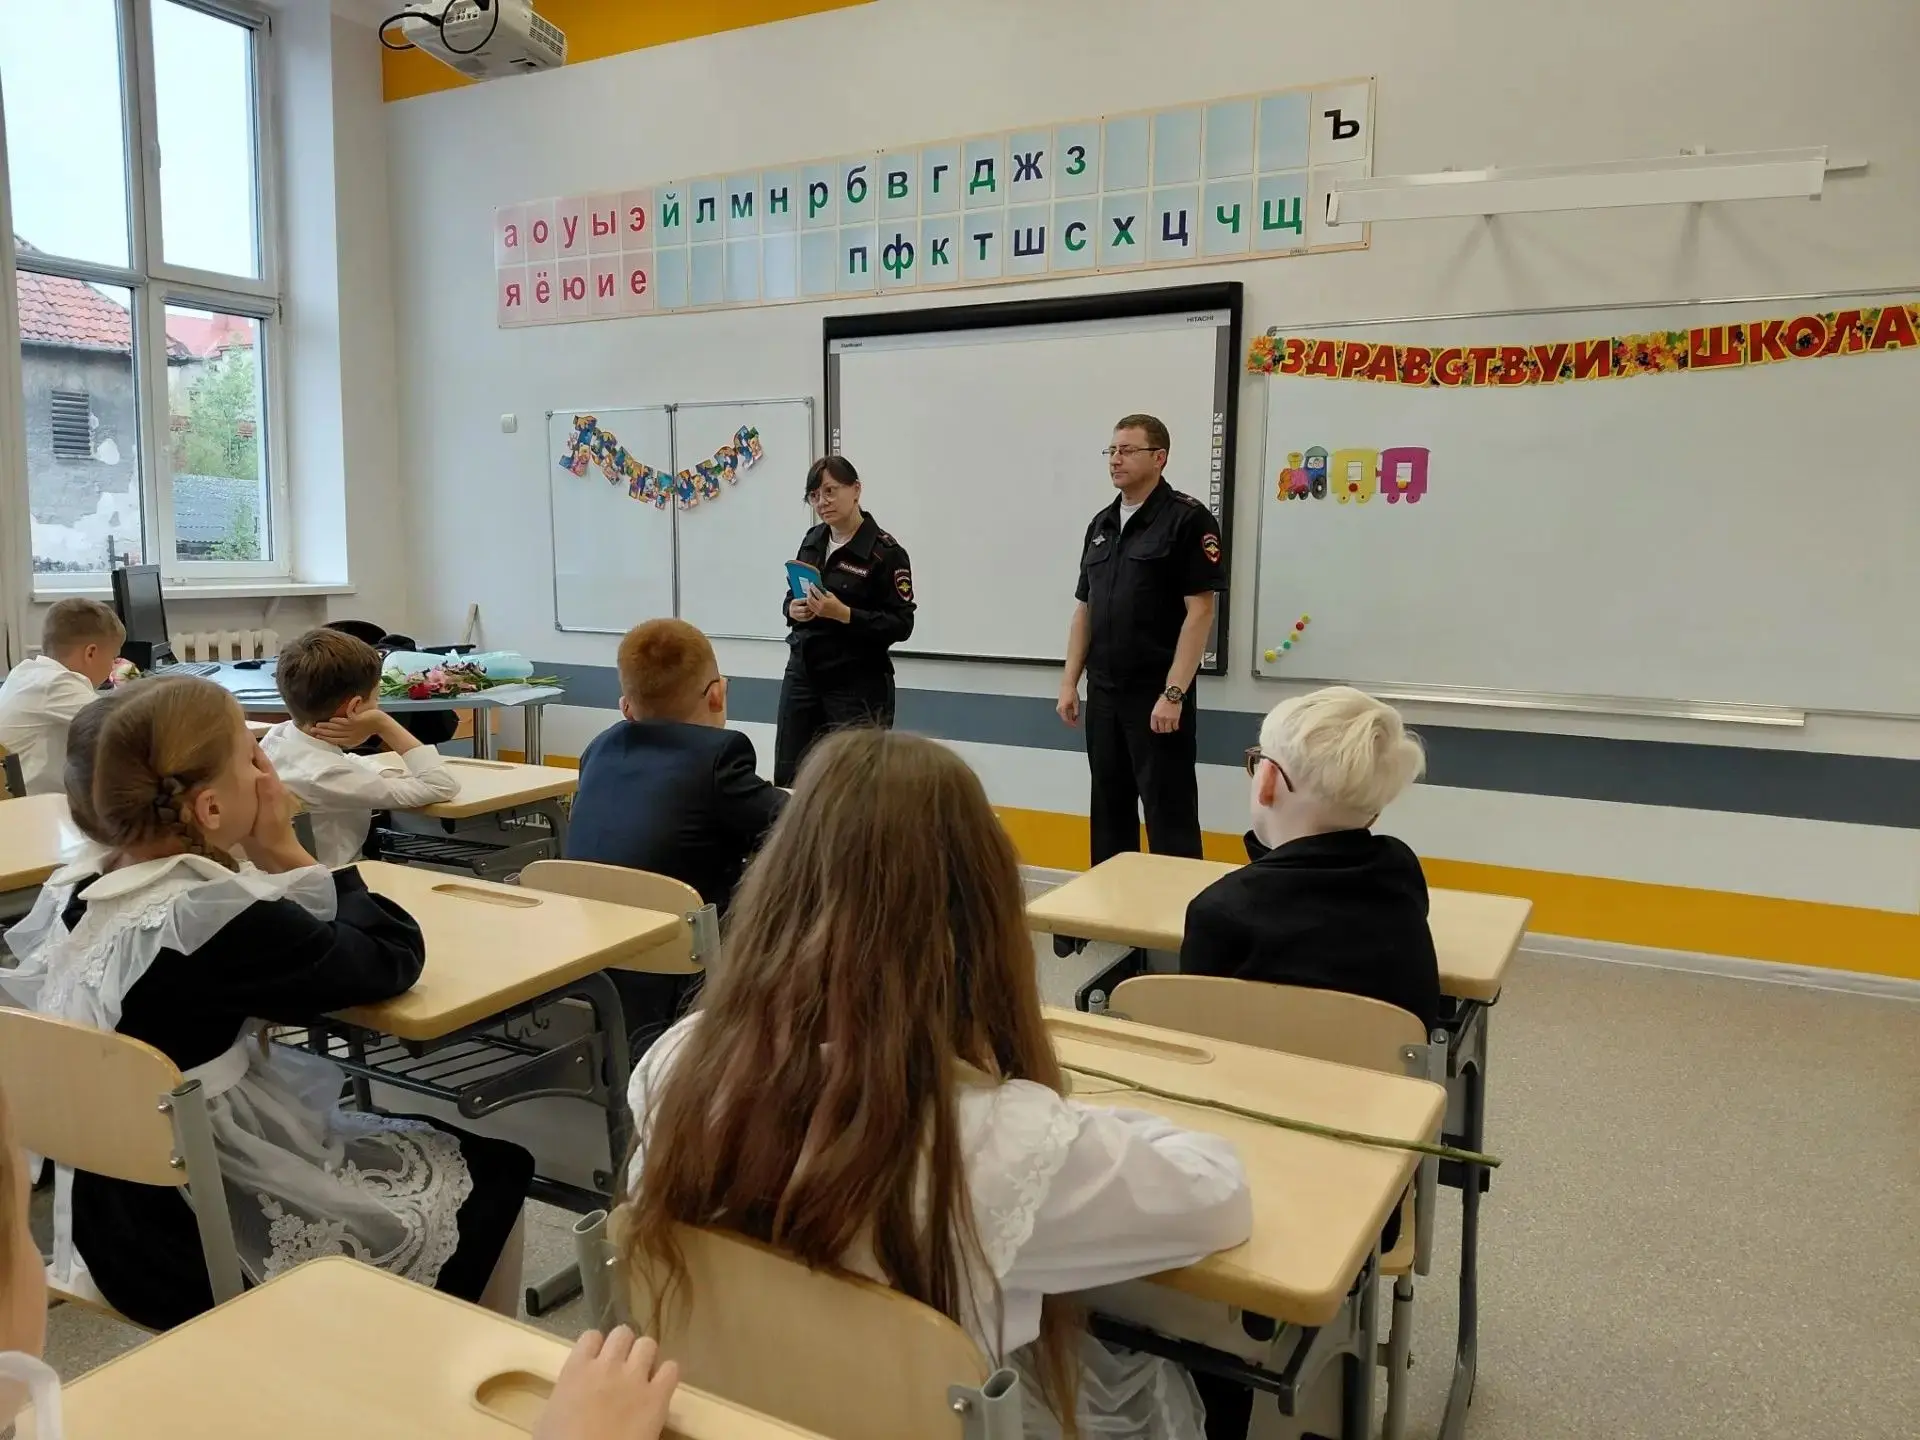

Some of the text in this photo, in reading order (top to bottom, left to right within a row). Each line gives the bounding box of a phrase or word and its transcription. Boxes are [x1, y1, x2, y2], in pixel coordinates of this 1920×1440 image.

[505, 109, 1360, 249] а о у ы э й л м н р б в г д ж з ъ
[506, 284, 521, 306] я
[536, 271, 550, 304] ё
[563, 277, 586, 301] ю
[598, 274, 615, 298] и
[631, 270, 647, 295] е
[850, 247, 868, 274] п
[883, 233, 915, 280] ф
[932, 238, 950, 265] к
[974, 233, 994, 260] т
[1014, 227, 1046, 256] ш
[1065, 222, 1087, 251] с
[1112, 216, 1136, 246] х
[1162, 210, 1189, 247] ц
[1217, 204, 1241, 233] ч
[1263, 197, 1303, 235] щ
[1689, 303, 1918, 371] ШКОЛА
